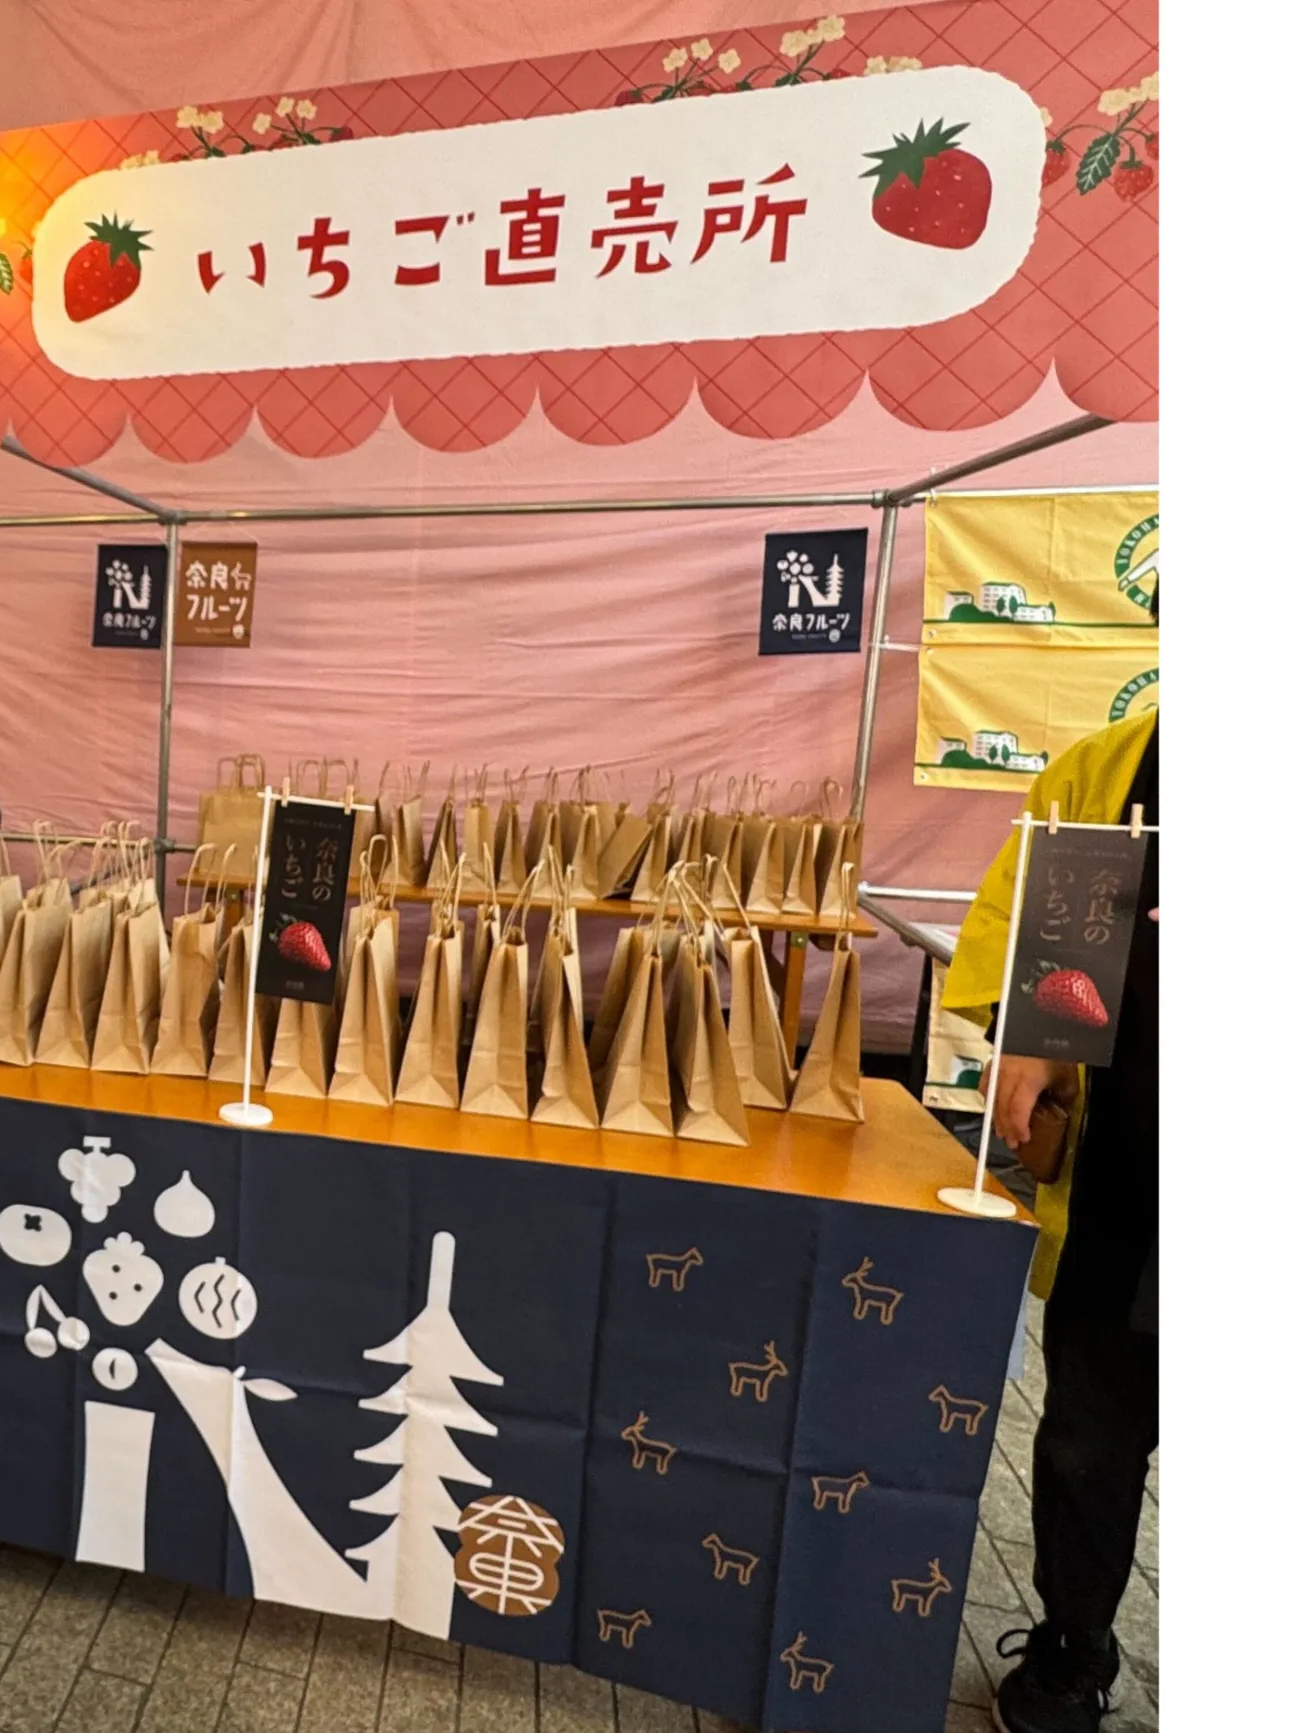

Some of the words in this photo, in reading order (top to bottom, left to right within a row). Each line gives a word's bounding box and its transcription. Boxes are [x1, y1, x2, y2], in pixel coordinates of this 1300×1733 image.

[196, 162, 809, 300] いちご直売所
[185, 560, 228, 591] 奈良
[185, 593, 249, 622] フルーツ
[102, 611, 157, 630] 奈良フルーツ
[771, 612, 851, 632] 奈良フルーツ
[280, 832, 306, 899] いちご
[311, 836, 339, 902] 奈良の
[1040, 867, 1075, 941] いちご
[1084, 869, 1122, 945] 奈良の
